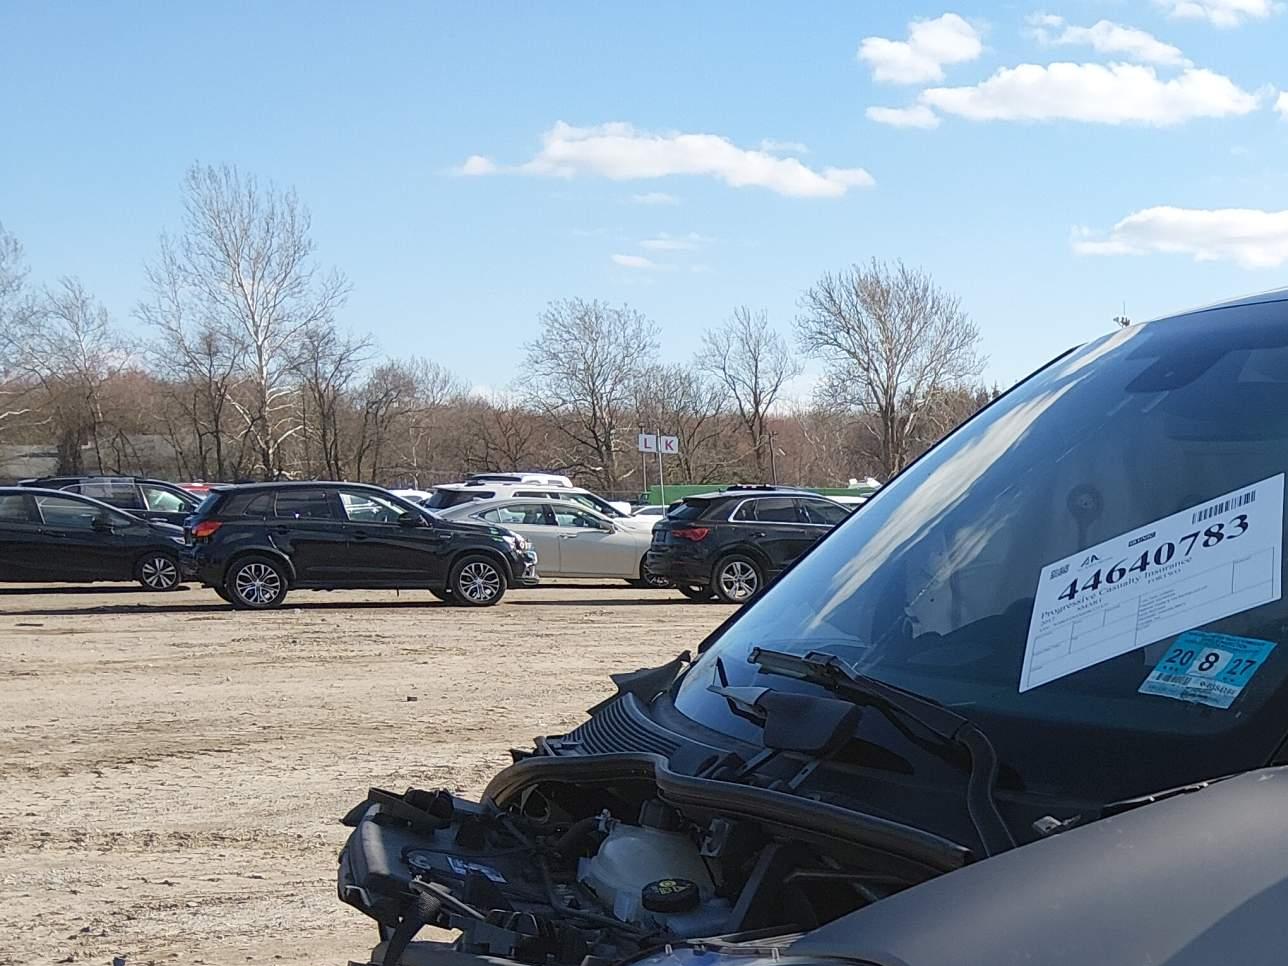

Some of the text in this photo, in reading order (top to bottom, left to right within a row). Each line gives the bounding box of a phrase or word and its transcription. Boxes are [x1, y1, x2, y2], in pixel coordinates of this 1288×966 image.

[644, 438, 652, 449] L
[665, 440, 674, 451] K
[1057, 513, 1249, 601] 44640783
[1040, 591, 1097, 620] Progressive
[1144, 556, 1193, 579] Insurance
[1165, 649, 1257, 675] 20 8 27
